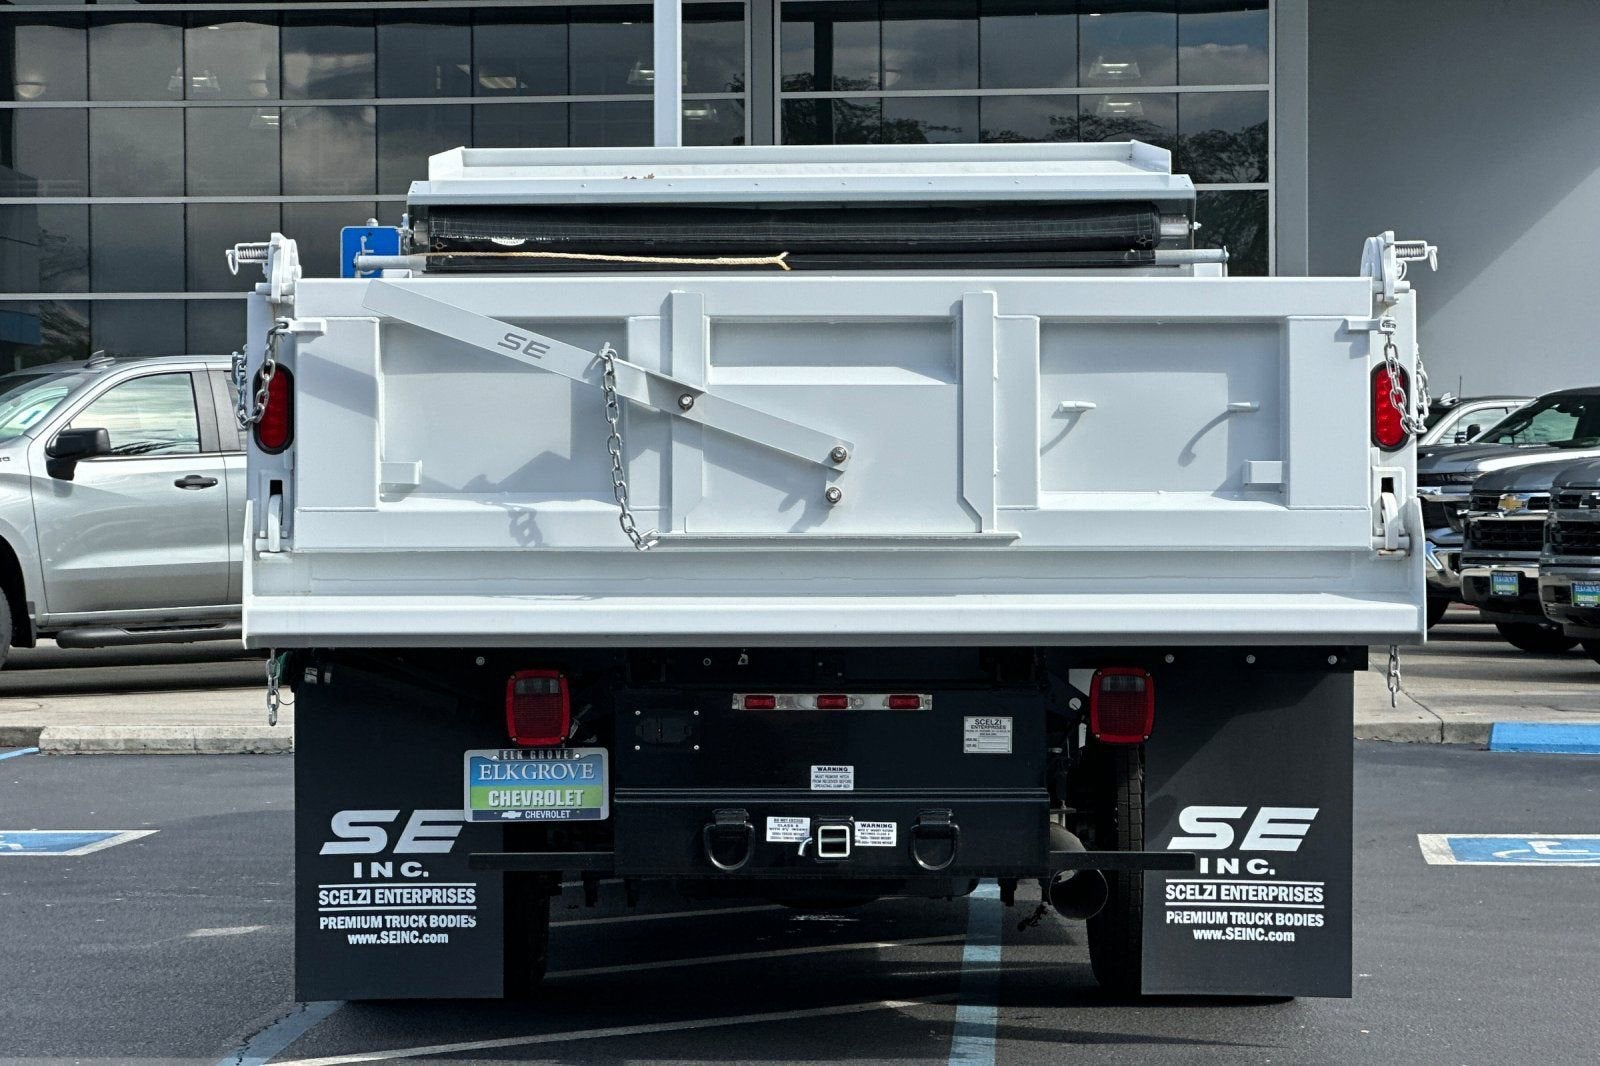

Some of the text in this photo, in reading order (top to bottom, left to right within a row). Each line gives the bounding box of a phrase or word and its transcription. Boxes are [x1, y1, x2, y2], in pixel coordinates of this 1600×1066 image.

[497, 332, 551, 359] SE
[975, 718, 1002, 726] SCELZI
[503, 750, 569, 759] ELK GROVE
[488, 789, 585, 808] CHEVROLET
[524, 810, 571, 819] CHEVROLET
[319, 810, 466, 855] SE
[1166, 805, 1320, 852] SE
[353, 861, 429, 878] INC.
[1200, 857, 1276, 875] INC.
[318, 888, 476, 905] SCELZI ENTERPRISES
[1166, 884, 1324, 903] SCELZI ENTERPRISES
[319, 914, 477, 930] PREMIUM TRUCK BODIES
[1166, 911, 1325, 927] PREMIUM TRUCK BODIES
[347, 930, 449, 945] www.SEINC.com
[1193, 927, 1296, 942] www.SEINC.com
